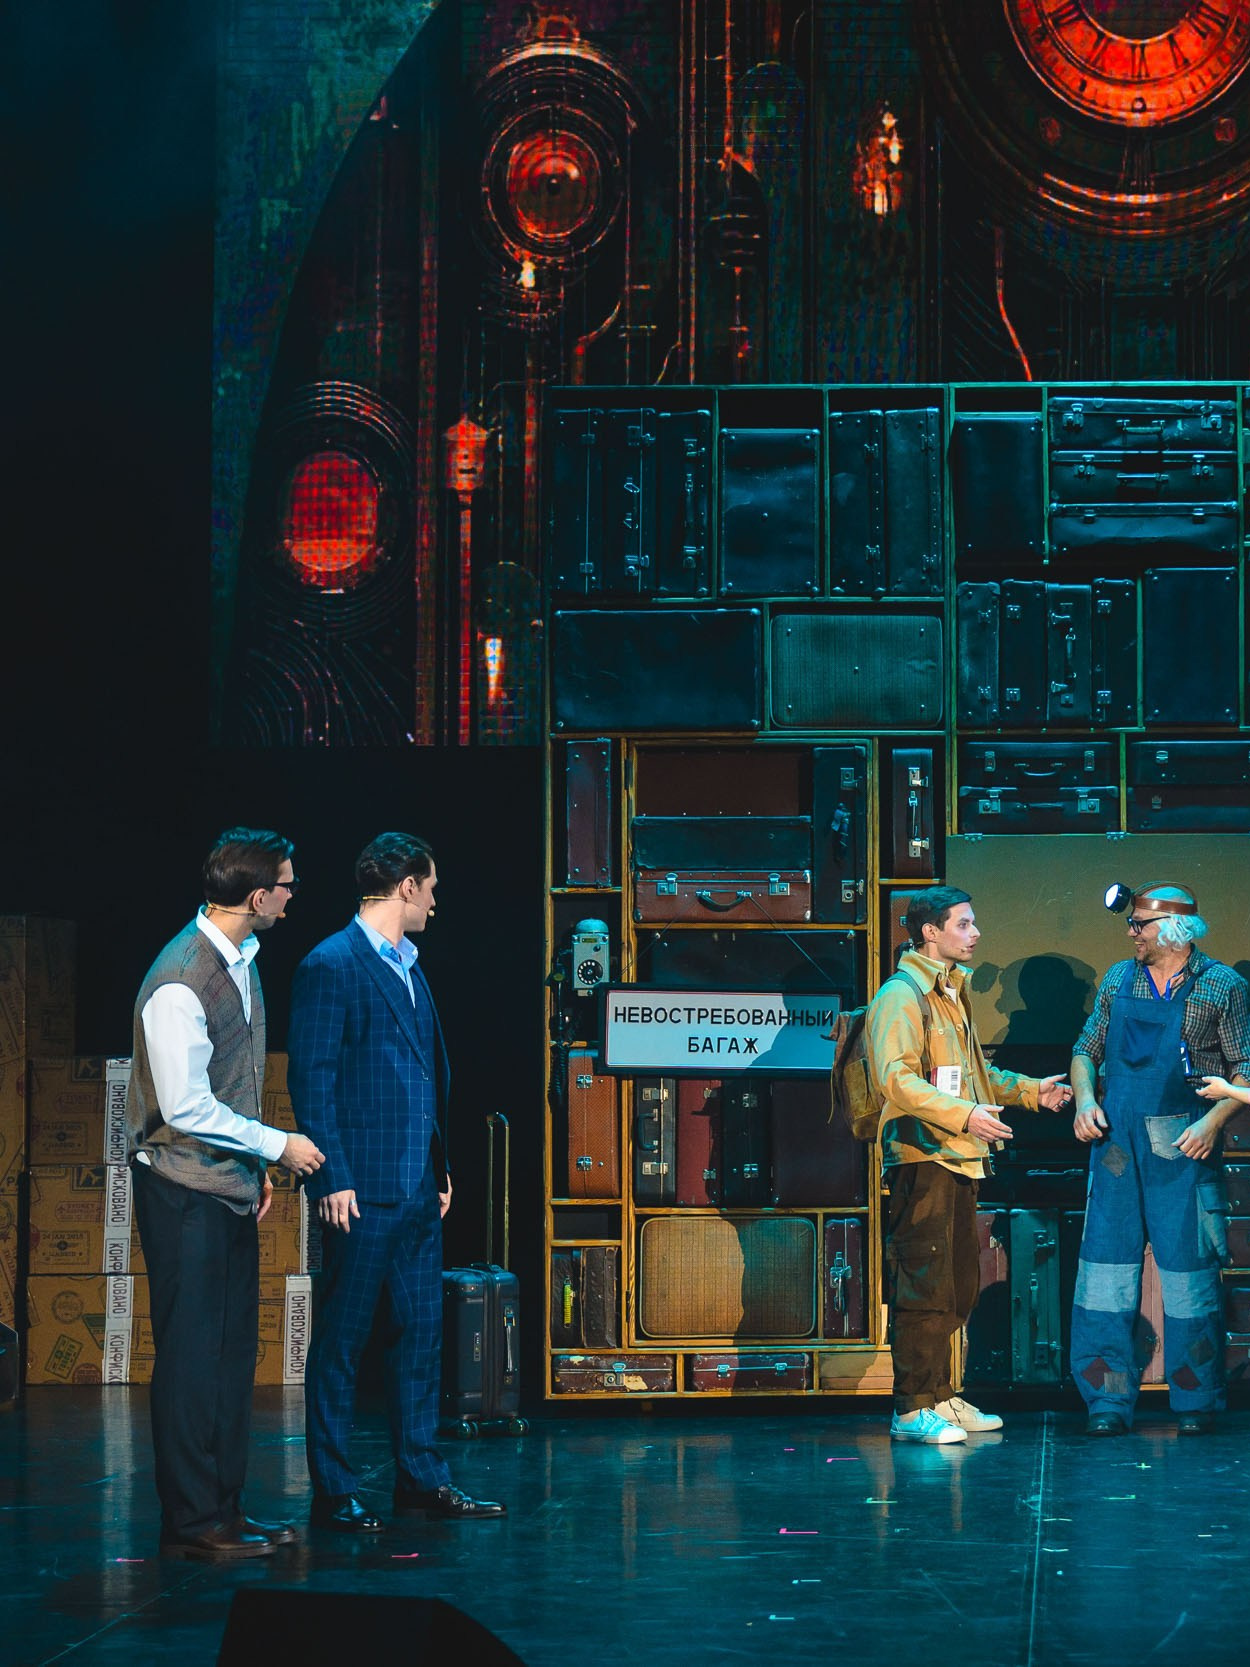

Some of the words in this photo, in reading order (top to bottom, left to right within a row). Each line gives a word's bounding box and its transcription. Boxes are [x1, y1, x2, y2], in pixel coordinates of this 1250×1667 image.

[687, 1036, 759, 1054] БАГАЖ
[110, 1083, 127, 1166] КОНФИСКОВАНО
[290, 1294, 306, 1375] КОНФИСКОВАНО
